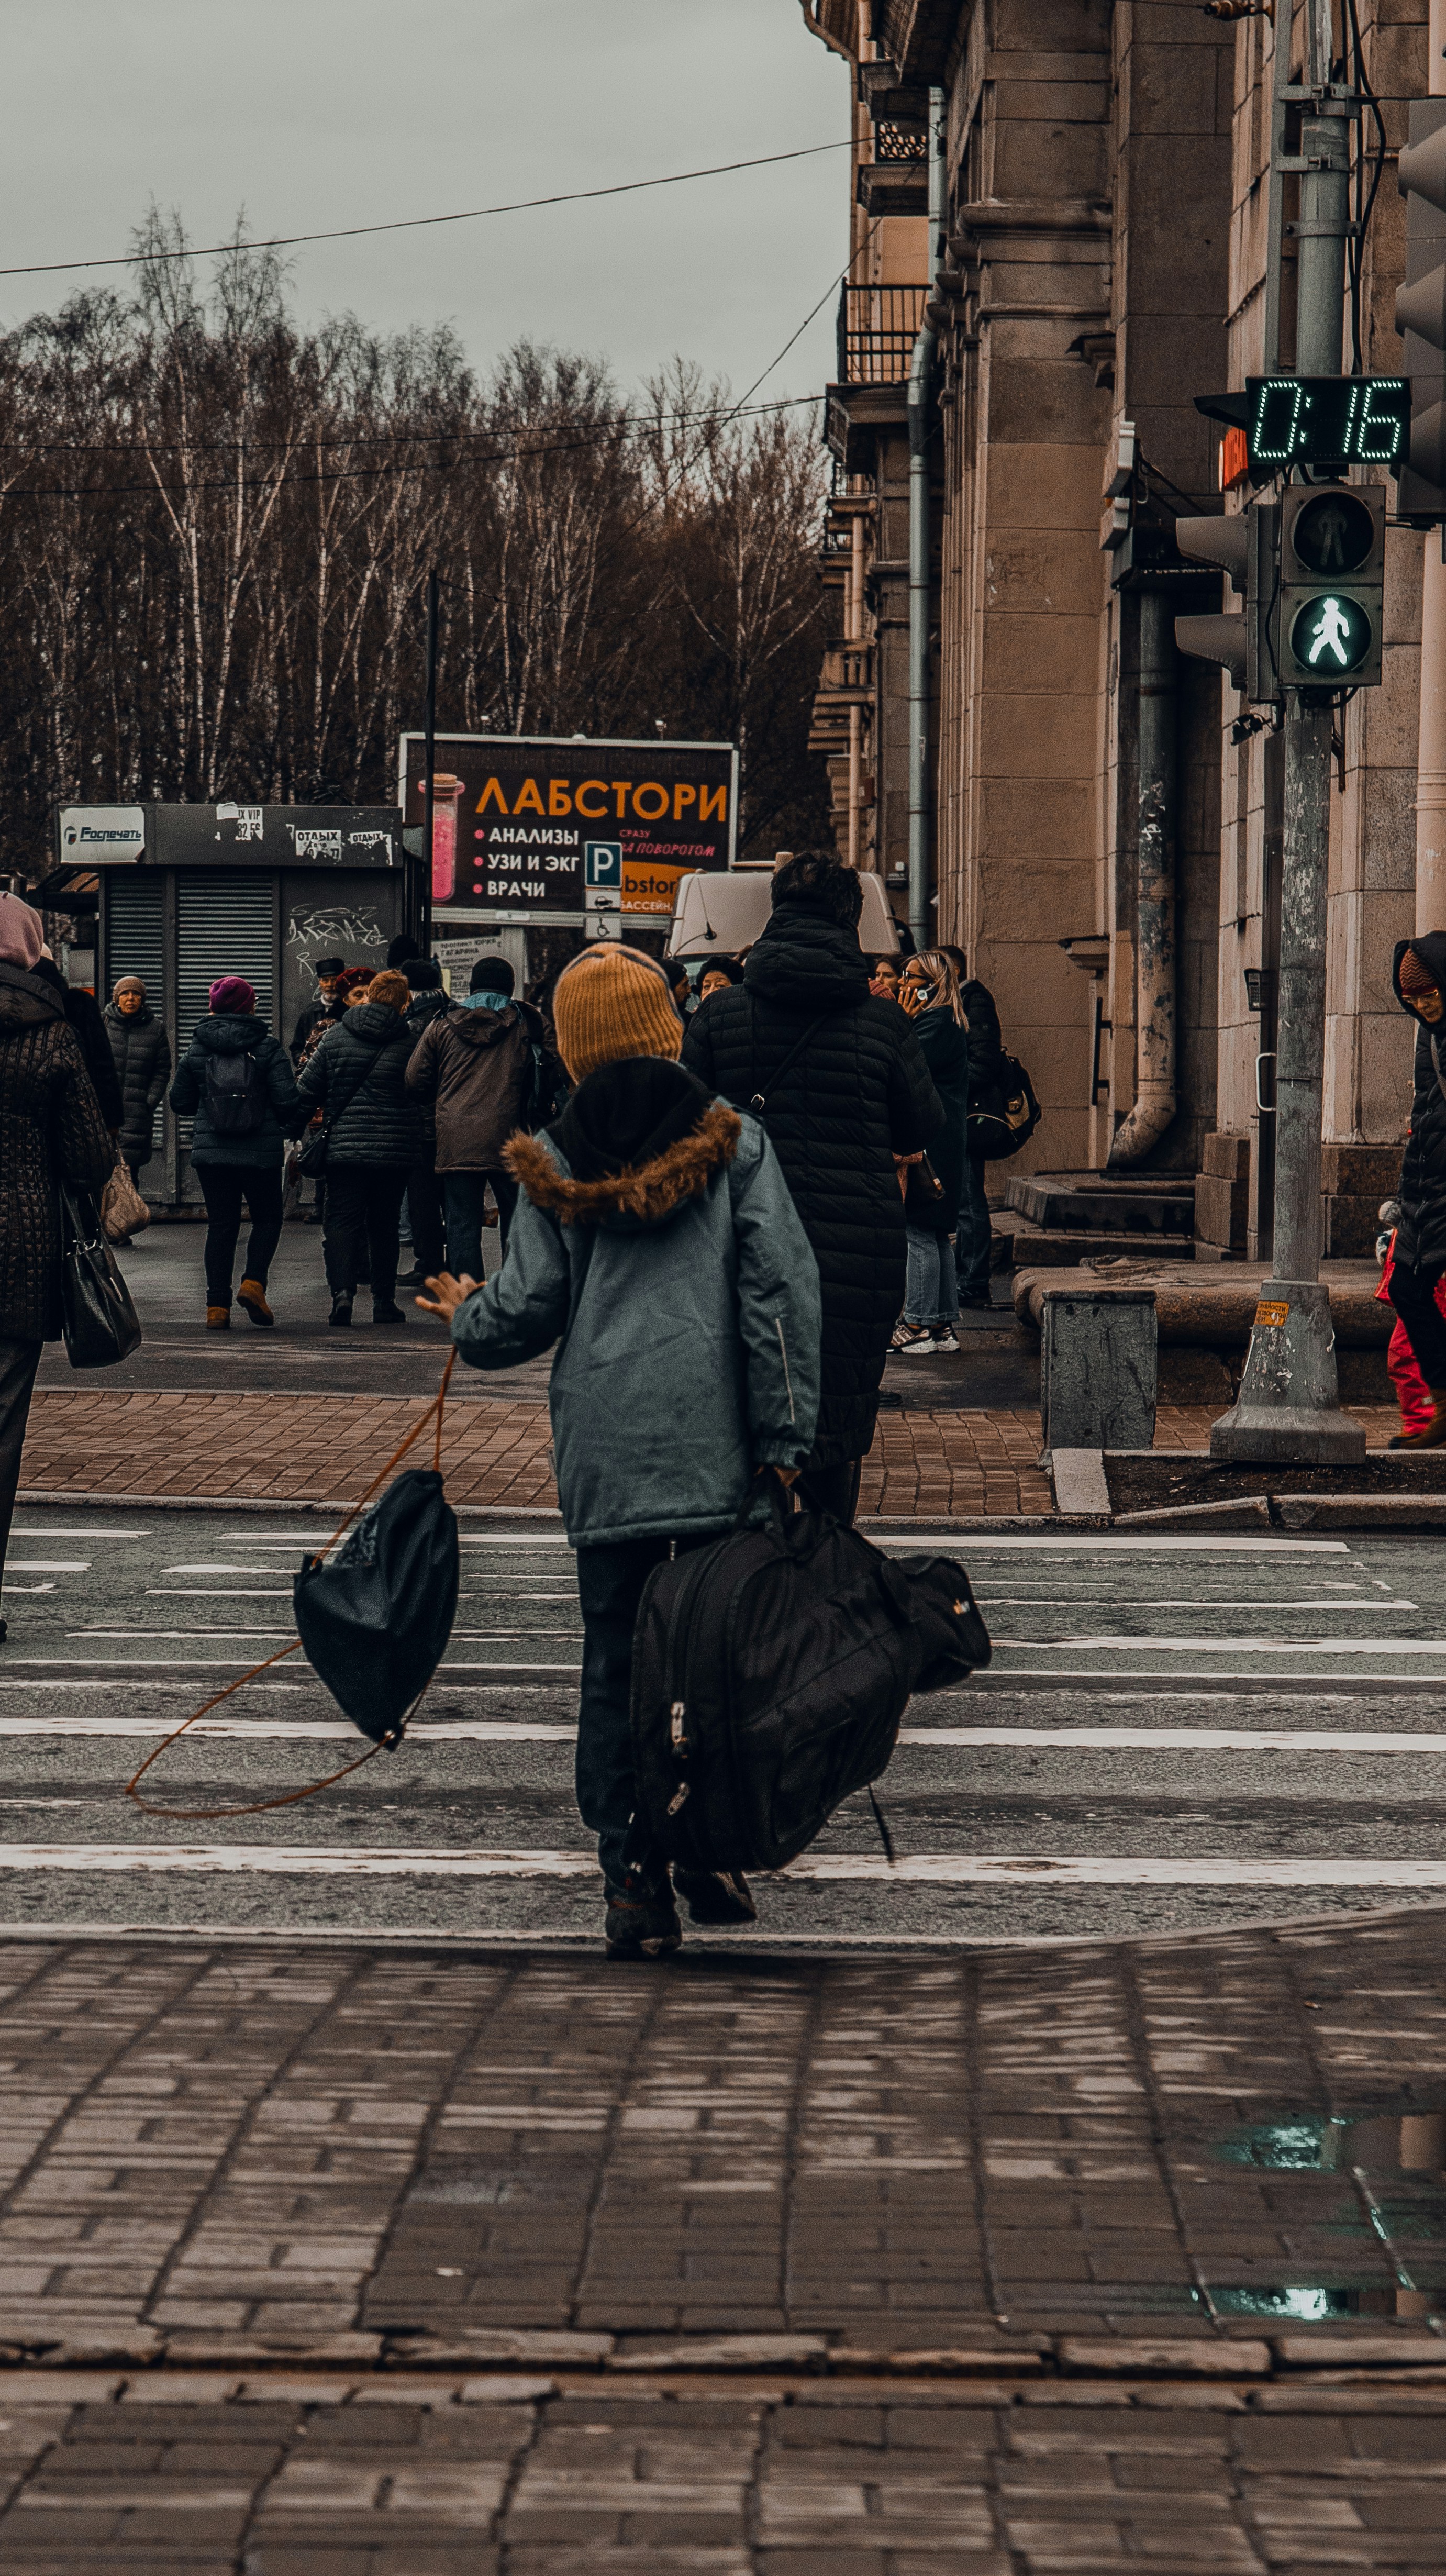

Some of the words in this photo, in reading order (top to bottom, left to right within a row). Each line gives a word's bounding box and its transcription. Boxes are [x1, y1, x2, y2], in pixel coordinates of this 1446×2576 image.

[1253, 381, 1403, 459] 0:16
[475, 777, 727, 821] ЛАБСТОРИ
[248, 809, 260, 820] VIP
[80, 827, 142, 842] Роспечать
[297, 832, 338, 841] ОТДЫХ
[488, 827, 579, 845] АНАЛИЗЫ
[619, 829, 651, 838] СРАЗУ
[636, 842, 716, 857] ПОВОРОТОМ
[487, 853, 522, 870] УЗИ
[527, 855, 539, 870] И
[544, 856, 580, 872] ЭКГ
[594, 847, 614, 882] P
[487, 880, 545, 897] ВРАЧИ
